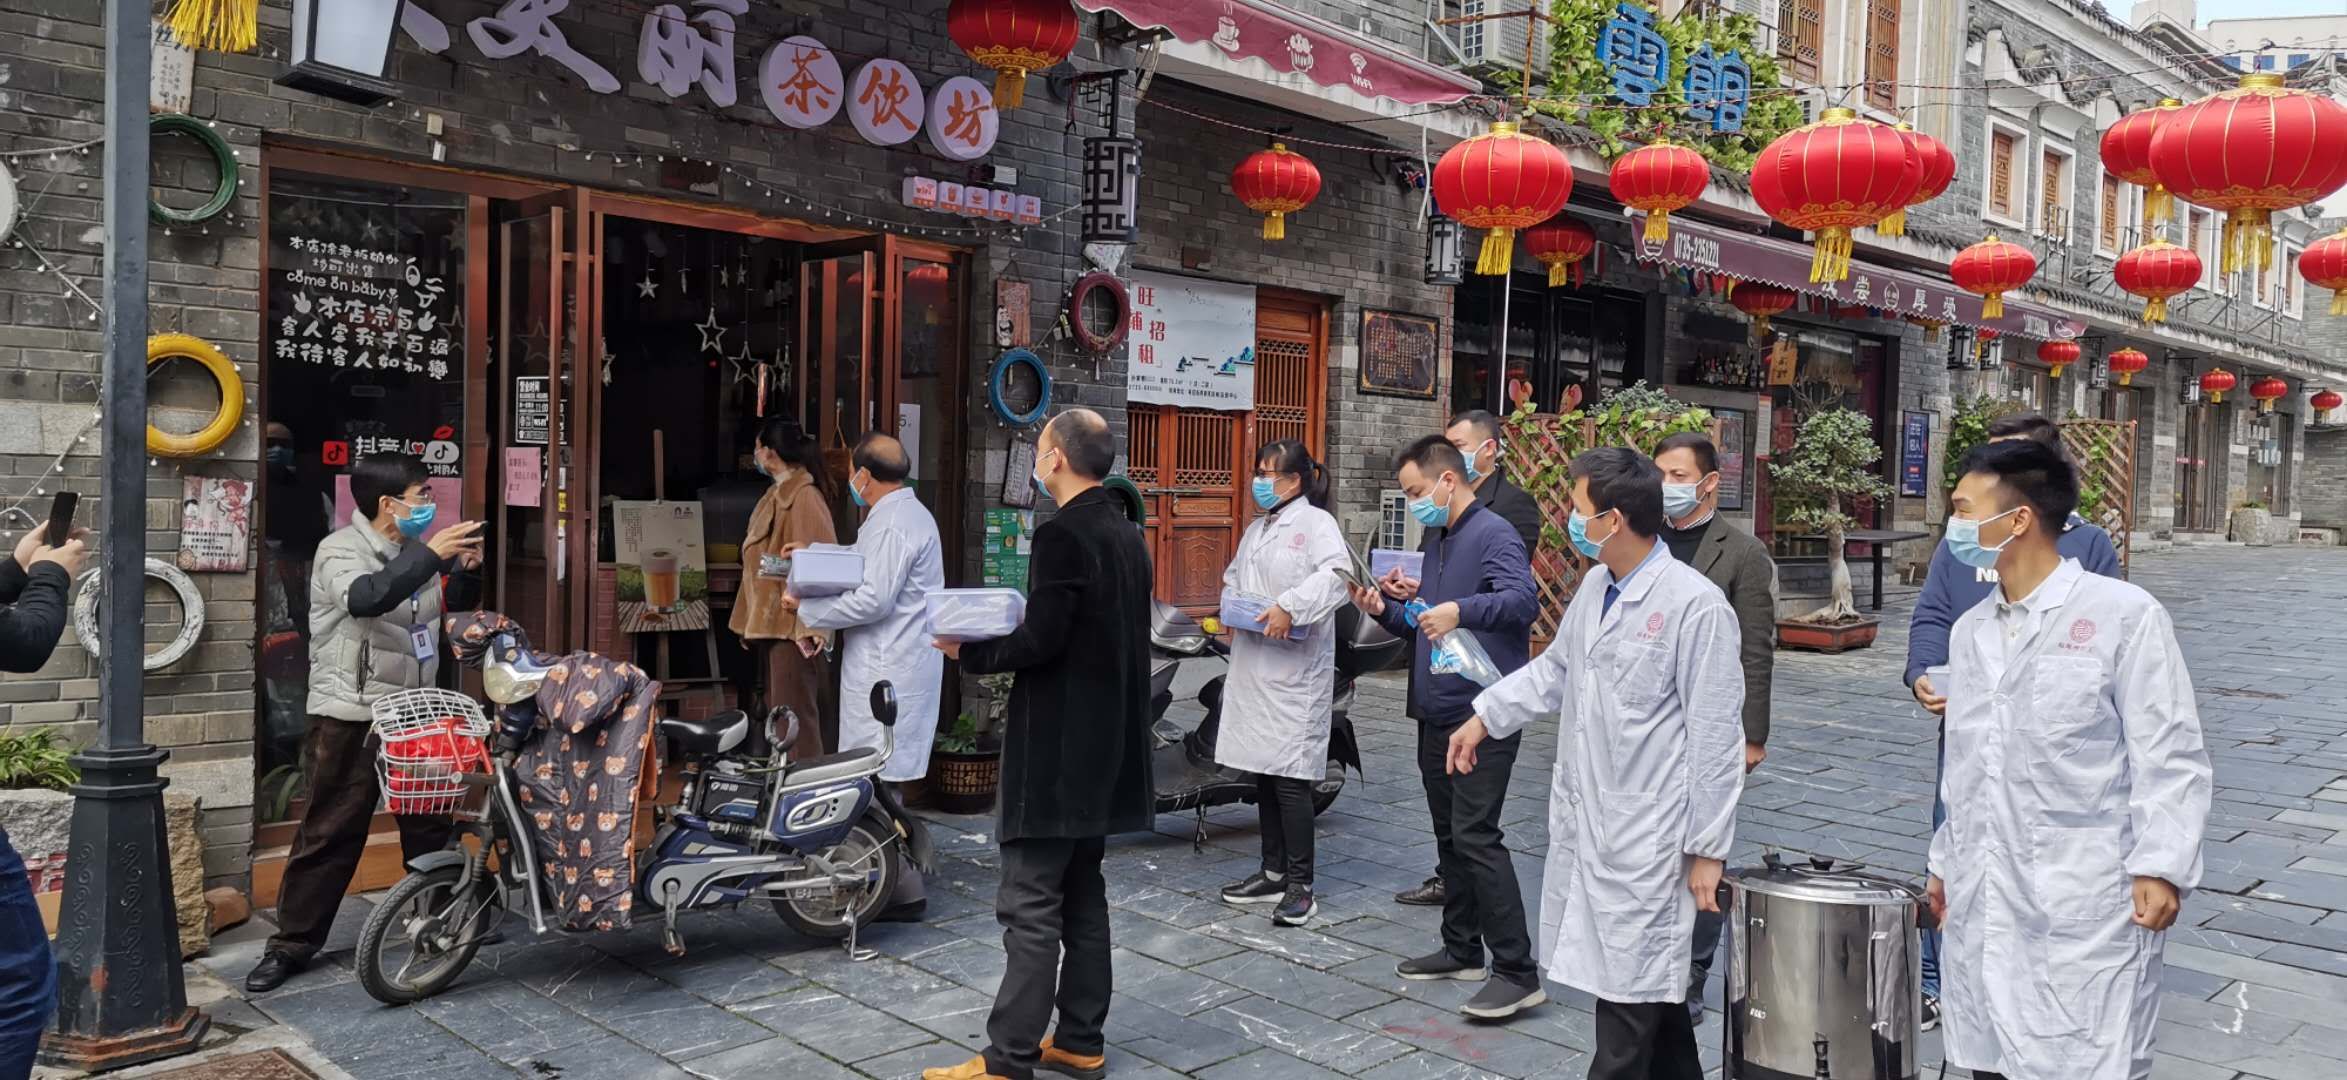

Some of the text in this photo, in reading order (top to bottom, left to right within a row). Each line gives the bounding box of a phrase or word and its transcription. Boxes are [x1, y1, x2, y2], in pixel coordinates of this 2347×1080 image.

[1596, 2, 1751, 133] 雲館
[778, 47, 990, 147] 茶饮坊
[289, 236, 400, 265] 本店除老板娘外
[286, 269, 386, 300] come on baby
[318, 296, 415, 331] 本店宗旨
[355, 435, 400, 455] 抖音
